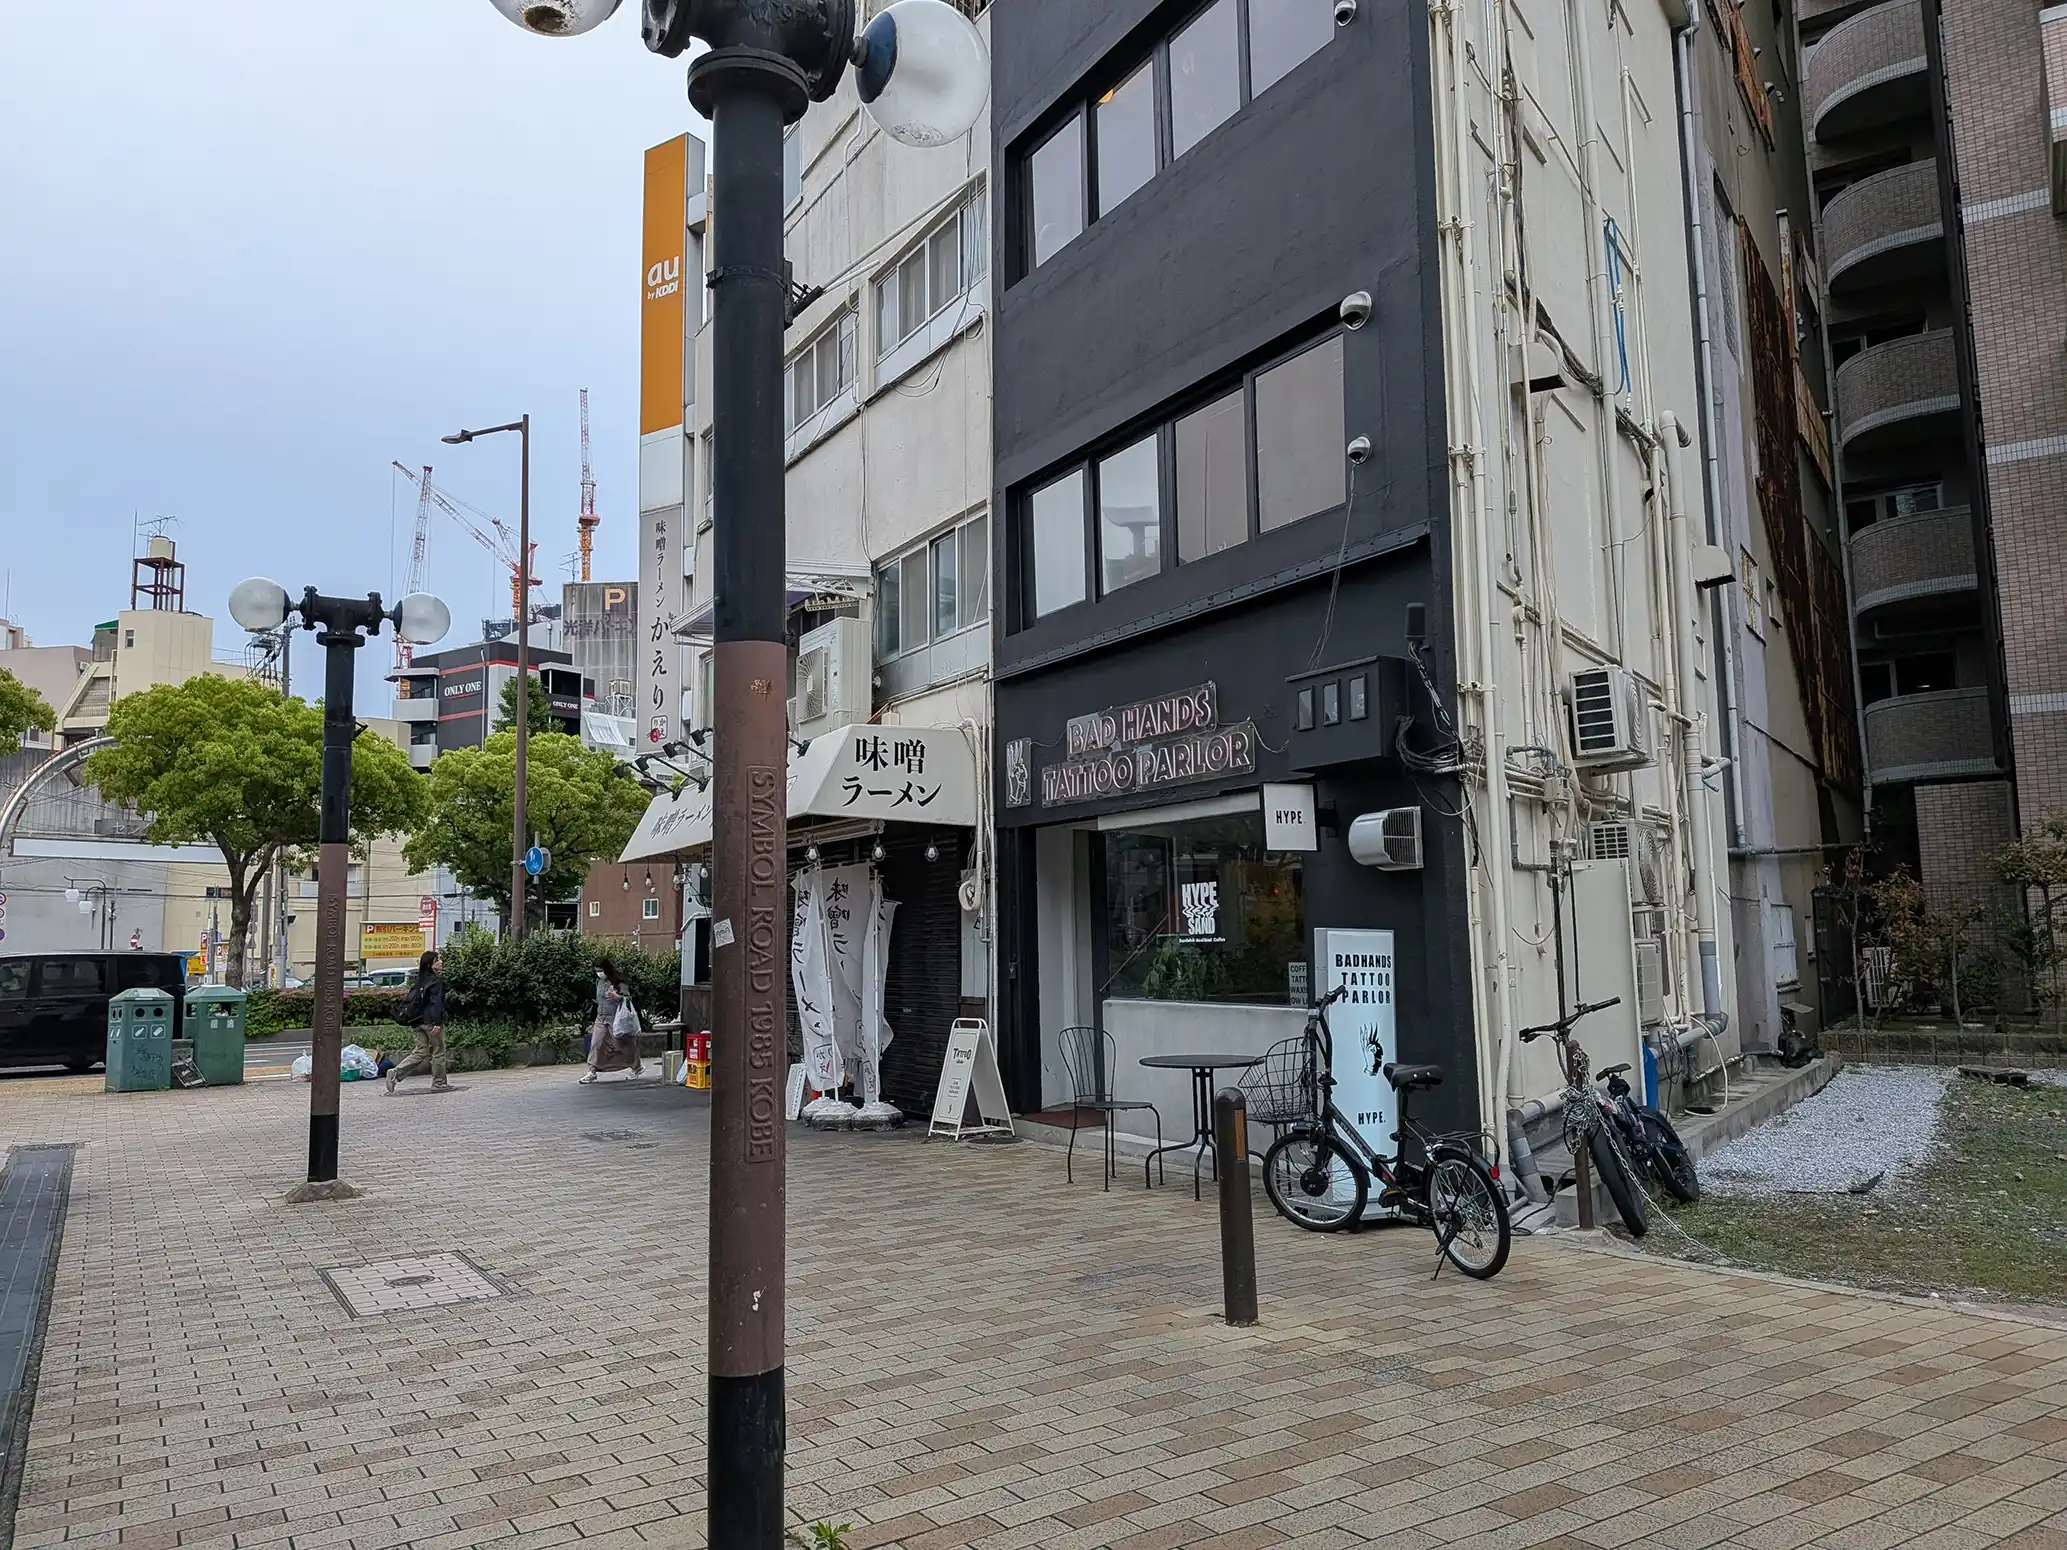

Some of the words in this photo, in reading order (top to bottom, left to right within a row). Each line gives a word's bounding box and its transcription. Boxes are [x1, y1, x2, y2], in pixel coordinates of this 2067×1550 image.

[648, 256, 679, 287] au
[647, 291, 655, 300] by
[655, 281, 679, 299] KDDI
[655, 519, 667, 608] 味噌ラーメン
[604, 588, 626, 610] P
[651, 617, 670, 711] かえり
[444, 683, 465, 697] ONLY
[465, 680, 482, 693] ONE
[567, 702, 579, 710] ONE
[1068, 716, 1116, 755] BAD
[1122, 689, 1213, 743] HANDS
[855, 735, 926, 774] 味噌
[1043, 755, 1134, 801] TATTOO
[1139, 732, 1251, 785] PARLOR
[841, 776, 943, 808] ラーメン
[751, 770, 776, 897] SYMBOL
[1181, 881, 1219, 912] HYPE
[1187, 915, 1215, 935] SAND
[750, 907, 774, 993] ROAD
[1335, 954, 1391, 968] BADHANDS
[1341, 972, 1390, 986] TATTOO
[1342, 990, 1391, 1004] PARLOR
[750, 1001, 774, 1070] 1985
[749, 1077, 774, 1156] KOBE
[1358, 1111, 1387, 1125] HYPE.
